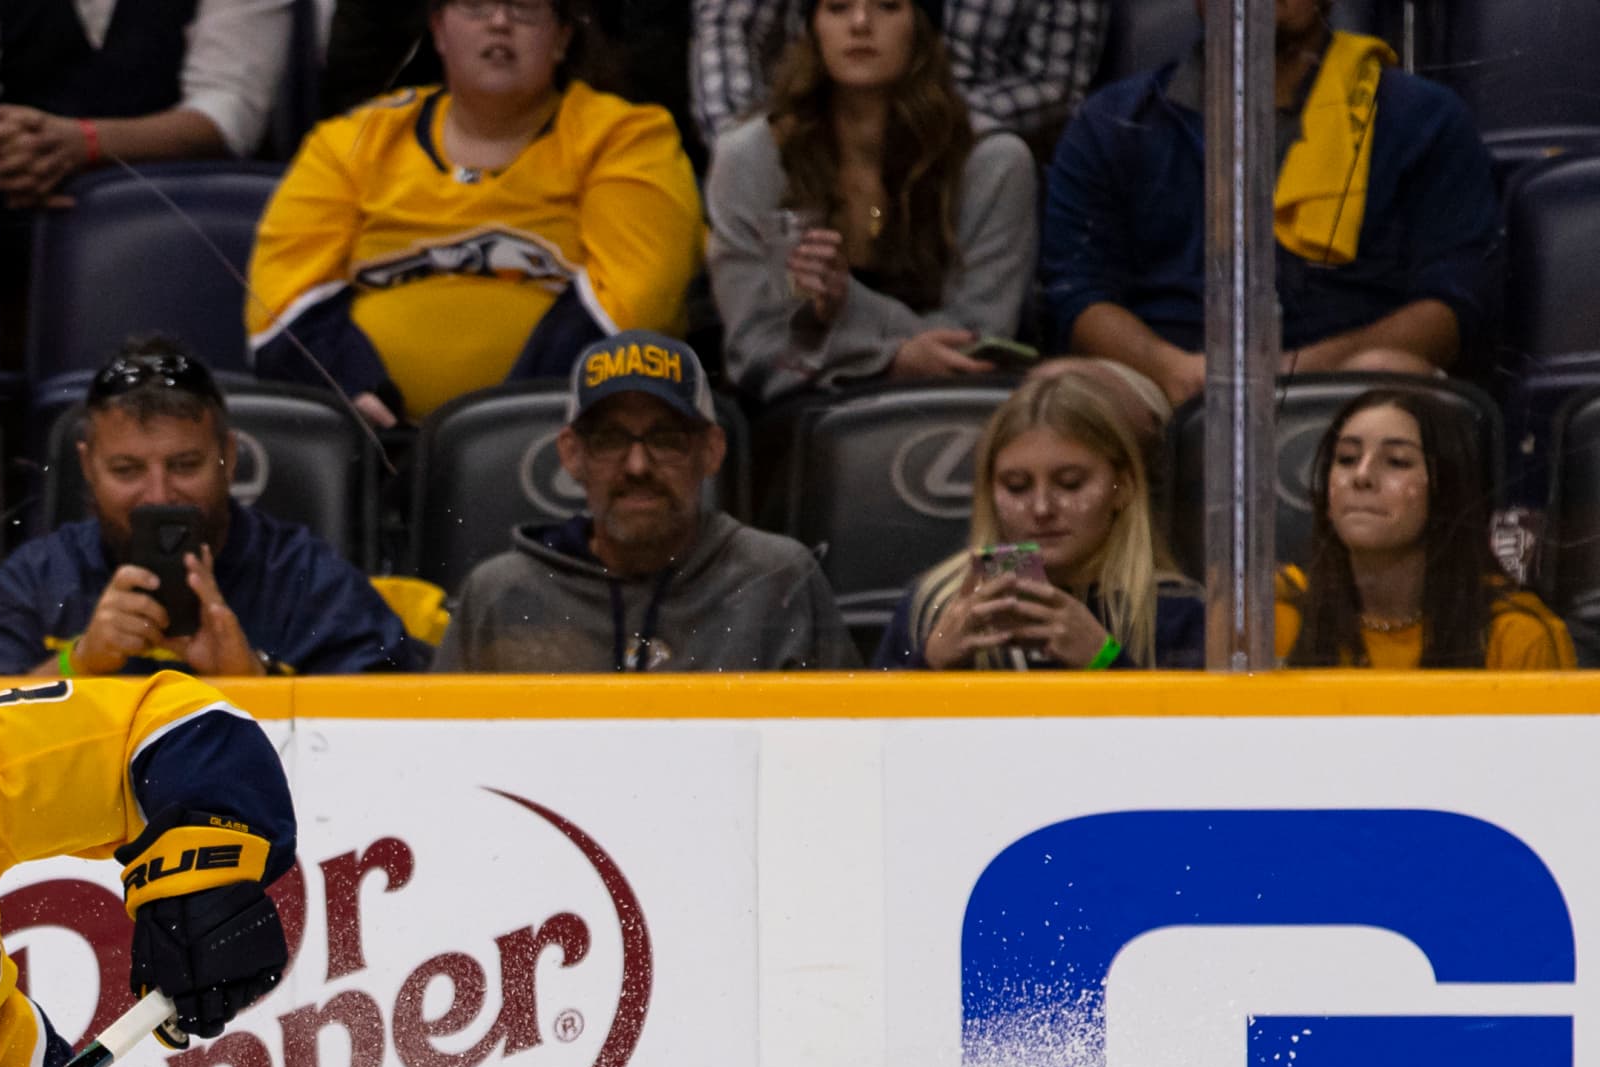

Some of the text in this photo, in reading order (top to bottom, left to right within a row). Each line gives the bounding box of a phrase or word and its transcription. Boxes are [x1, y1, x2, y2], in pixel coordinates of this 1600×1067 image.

[586, 343, 682, 388] SMASH
[210, 816, 249, 833] GLASS
[125, 845, 243, 889] RUE
[240, 837, 414, 1010] r
